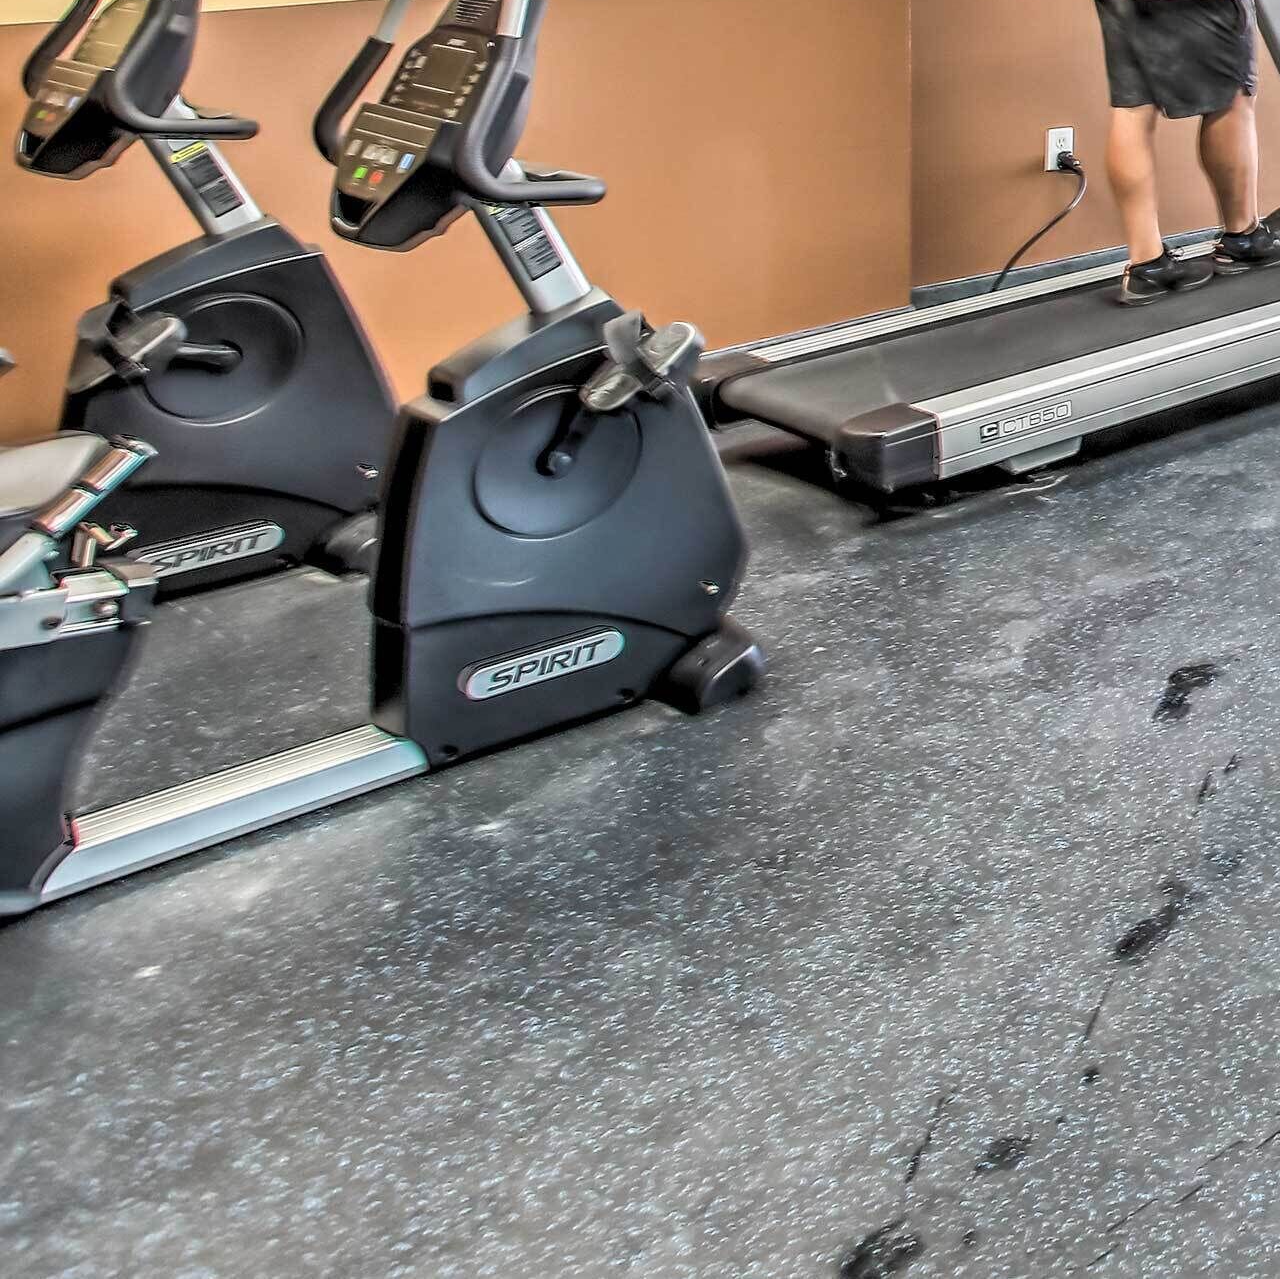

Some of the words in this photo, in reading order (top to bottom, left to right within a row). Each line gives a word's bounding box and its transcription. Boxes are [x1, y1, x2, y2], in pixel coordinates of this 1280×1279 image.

[1003, 405, 1069, 434] CT850
[150, 532, 267, 574] SPIRIT
[486, 638, 607, 692] SPIRIT
